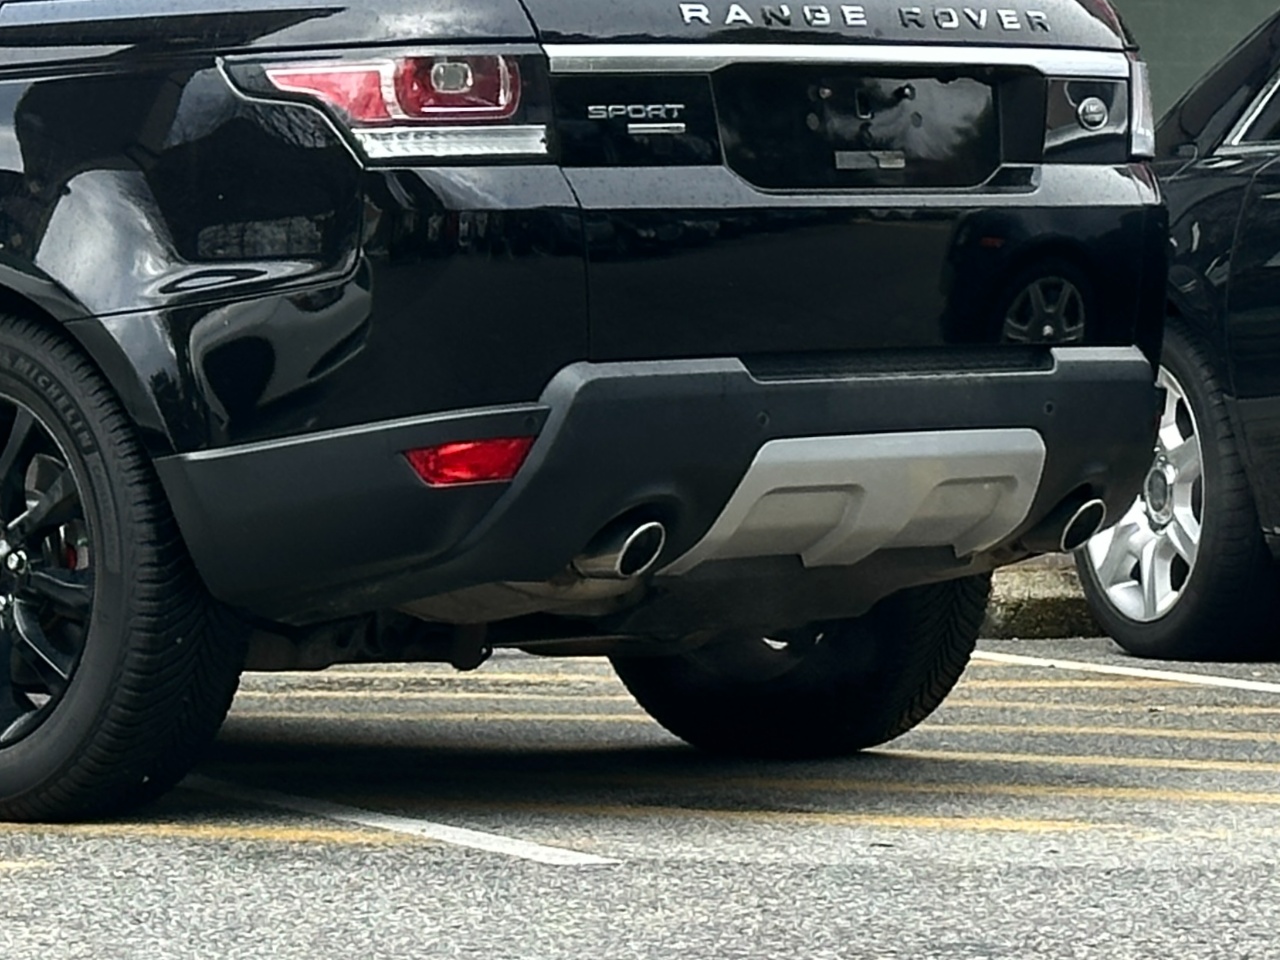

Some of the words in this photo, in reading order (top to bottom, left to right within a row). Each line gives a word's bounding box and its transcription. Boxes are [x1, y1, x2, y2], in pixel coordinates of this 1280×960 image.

[678, 2, 868, 27] RANGE
[898, 6, 1052, 33] ROVER
[587, 103, 685, 119] SPORT
[14, 357, 94, 451] MICHELIN
